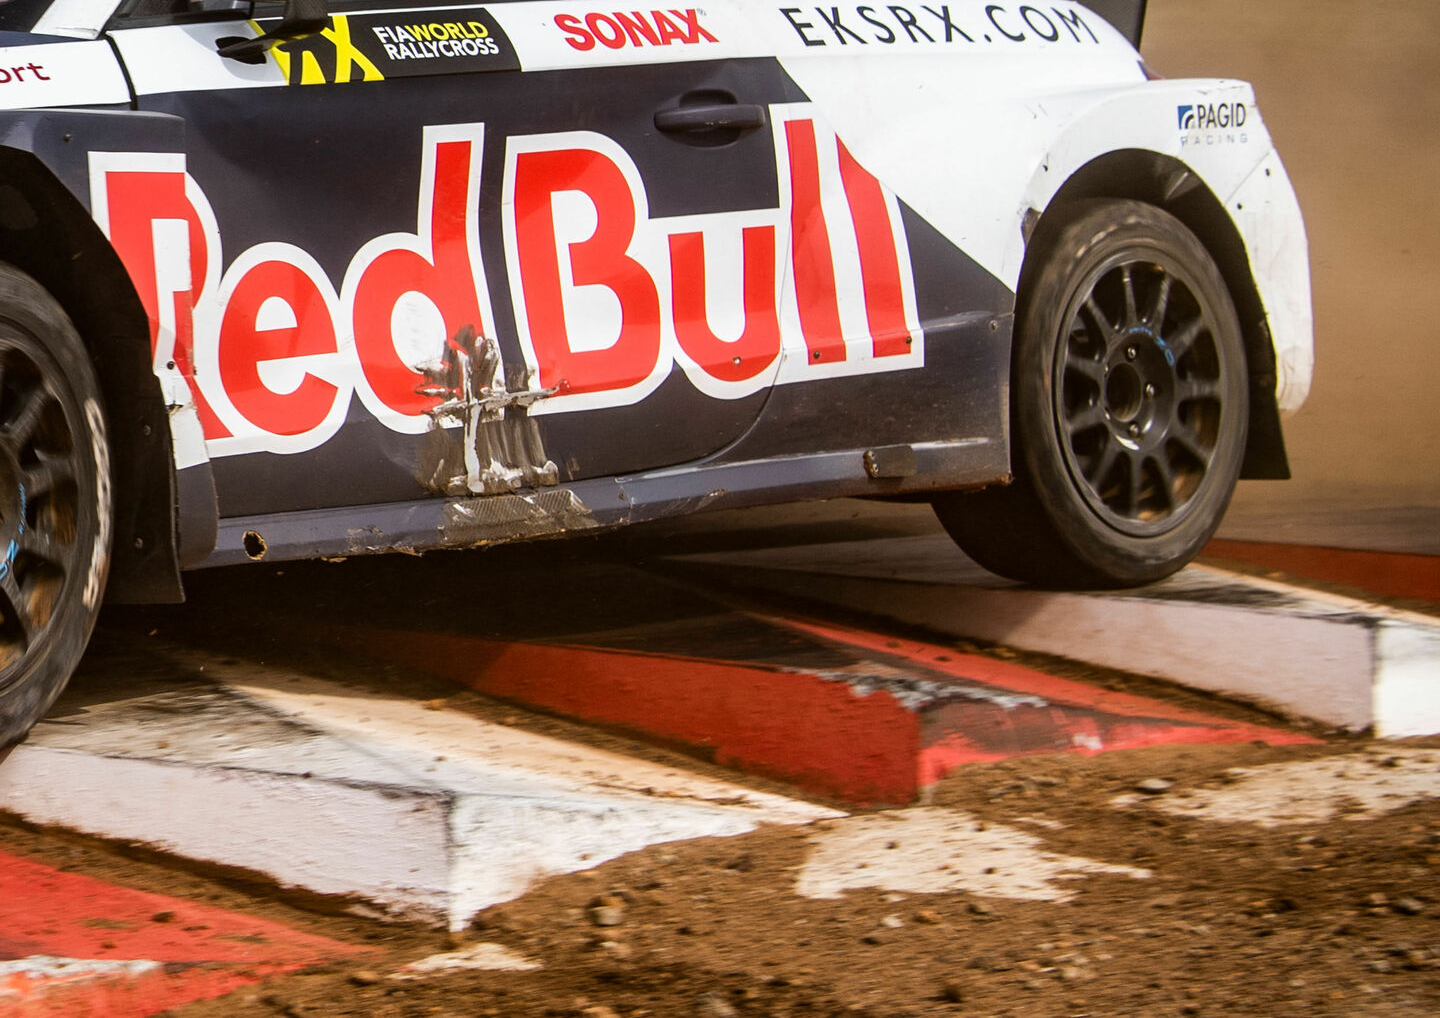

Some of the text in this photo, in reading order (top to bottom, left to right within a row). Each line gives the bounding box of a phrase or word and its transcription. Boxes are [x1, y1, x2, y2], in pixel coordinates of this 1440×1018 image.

[553, 8, 720, 52] SONAX
[780, 4, 1100, 47] EKSRX.COM
[383, 37, 500, 61] RALLYCROSS
[1196, 102, 1247, 130] PAGID
[1179, 132, 1249, 148] RACING
[96, 110, 918, 452] Red Bull
